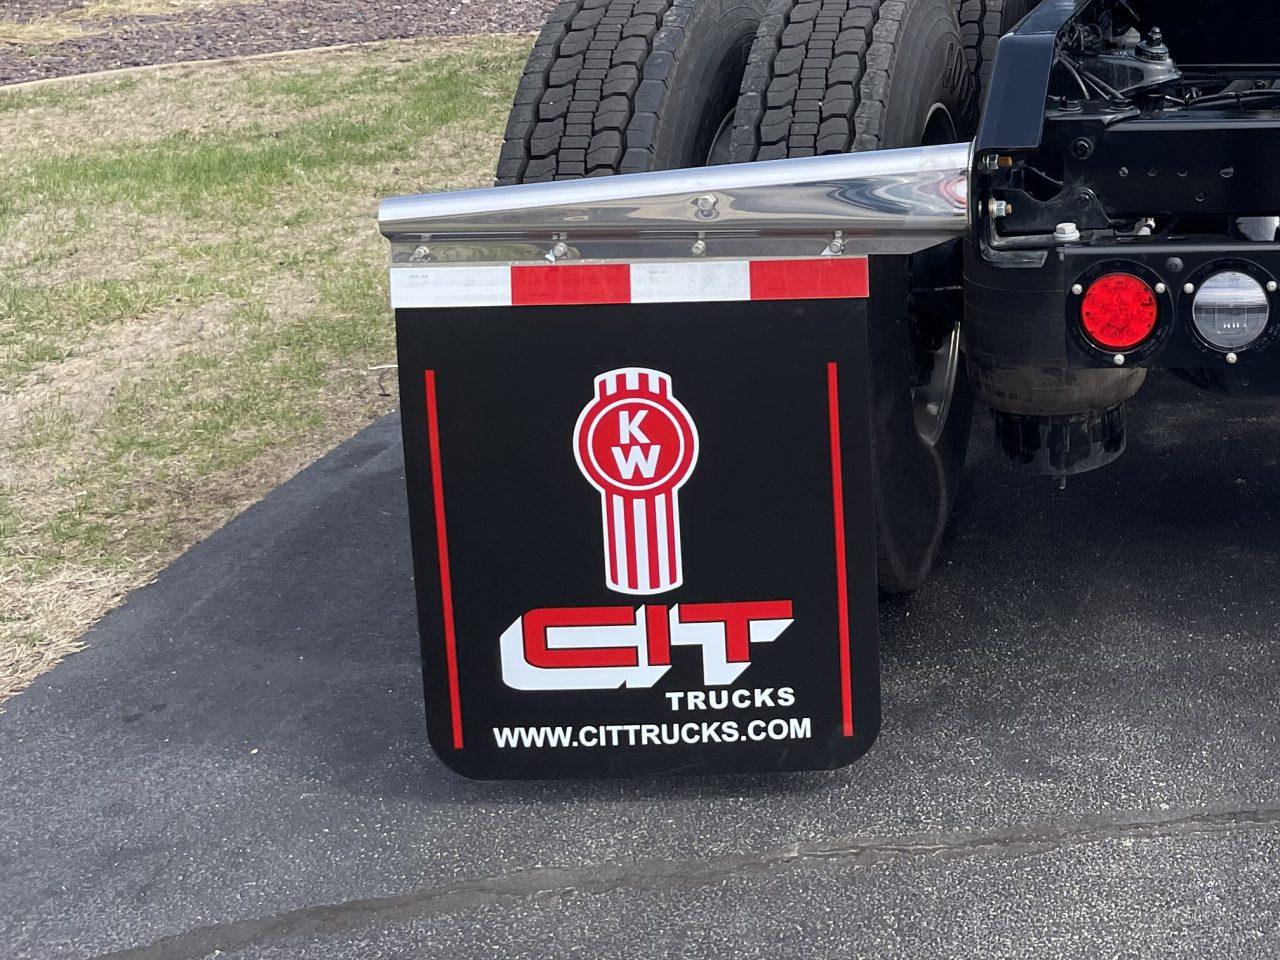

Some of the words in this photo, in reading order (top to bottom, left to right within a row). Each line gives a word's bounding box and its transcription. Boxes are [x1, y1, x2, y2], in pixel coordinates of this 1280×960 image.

[618, 410, 651, 444] K
[611, 444, 661, 479] W
[500, 599, 794, 690] CIT
[666, 687, 795, 711] TRUCKS
[493, 717, 812, 748] WWW.CITTRUCKS.COM
